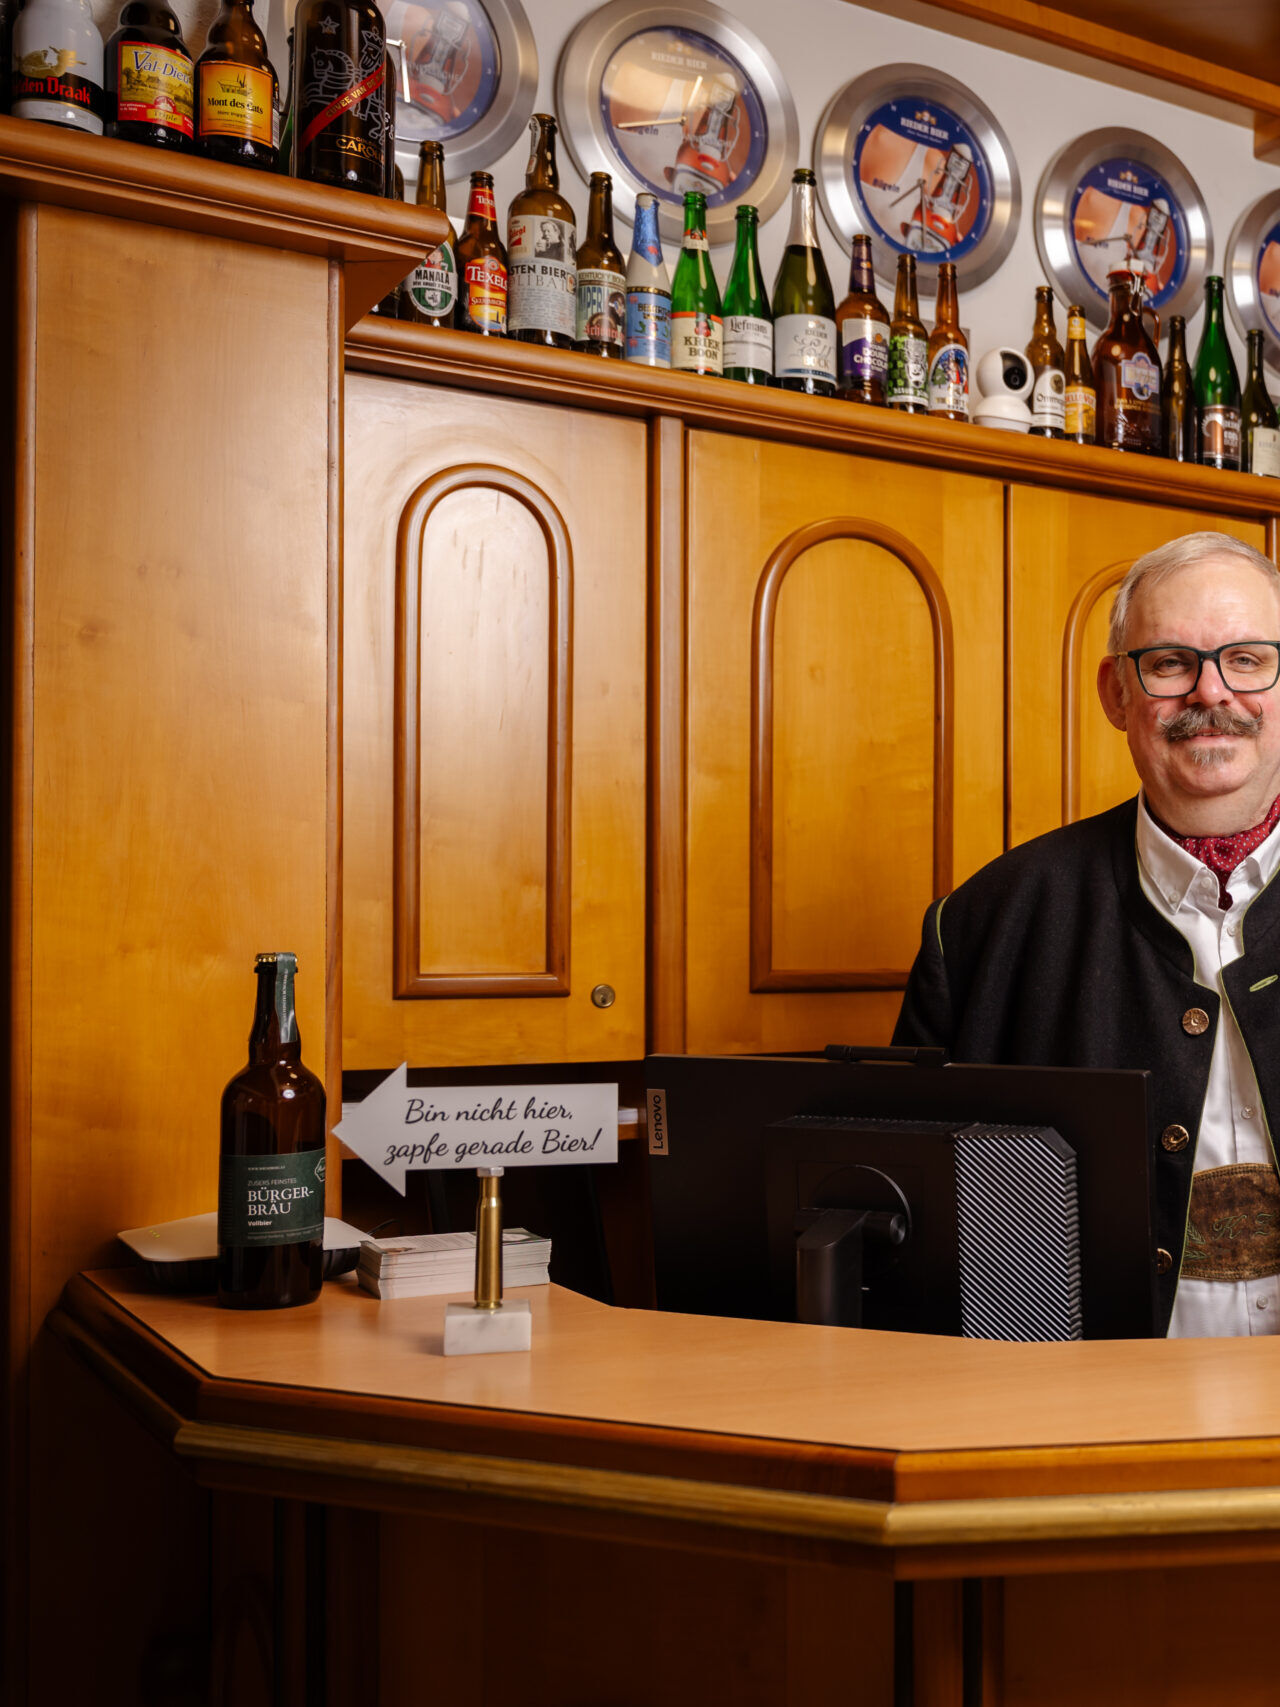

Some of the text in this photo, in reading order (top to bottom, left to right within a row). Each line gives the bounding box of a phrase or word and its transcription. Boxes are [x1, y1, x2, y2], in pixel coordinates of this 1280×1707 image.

[46, 76, 91, 105] Draak
[351, 86, 367, 98] VAN
[207, 97, 227, 107] Mont
[229, 99, 245, 109] des
[246, 102, 264, 115] Cats
[415, 269, 450, 285] MANALA
[541, 265, 566, 279] BIER
[405, 1098, 449, 1124] Bin
[455, 1097, 518, 1121] nicht
[653, 1095, 664, 1150] Lenovo
[383, 1127, 603, 1165] zapfe gerade Bier!
[247, 1186, 314, 1202] BÜRGER-
[247, 1200, 292, 1216] BRÄU
